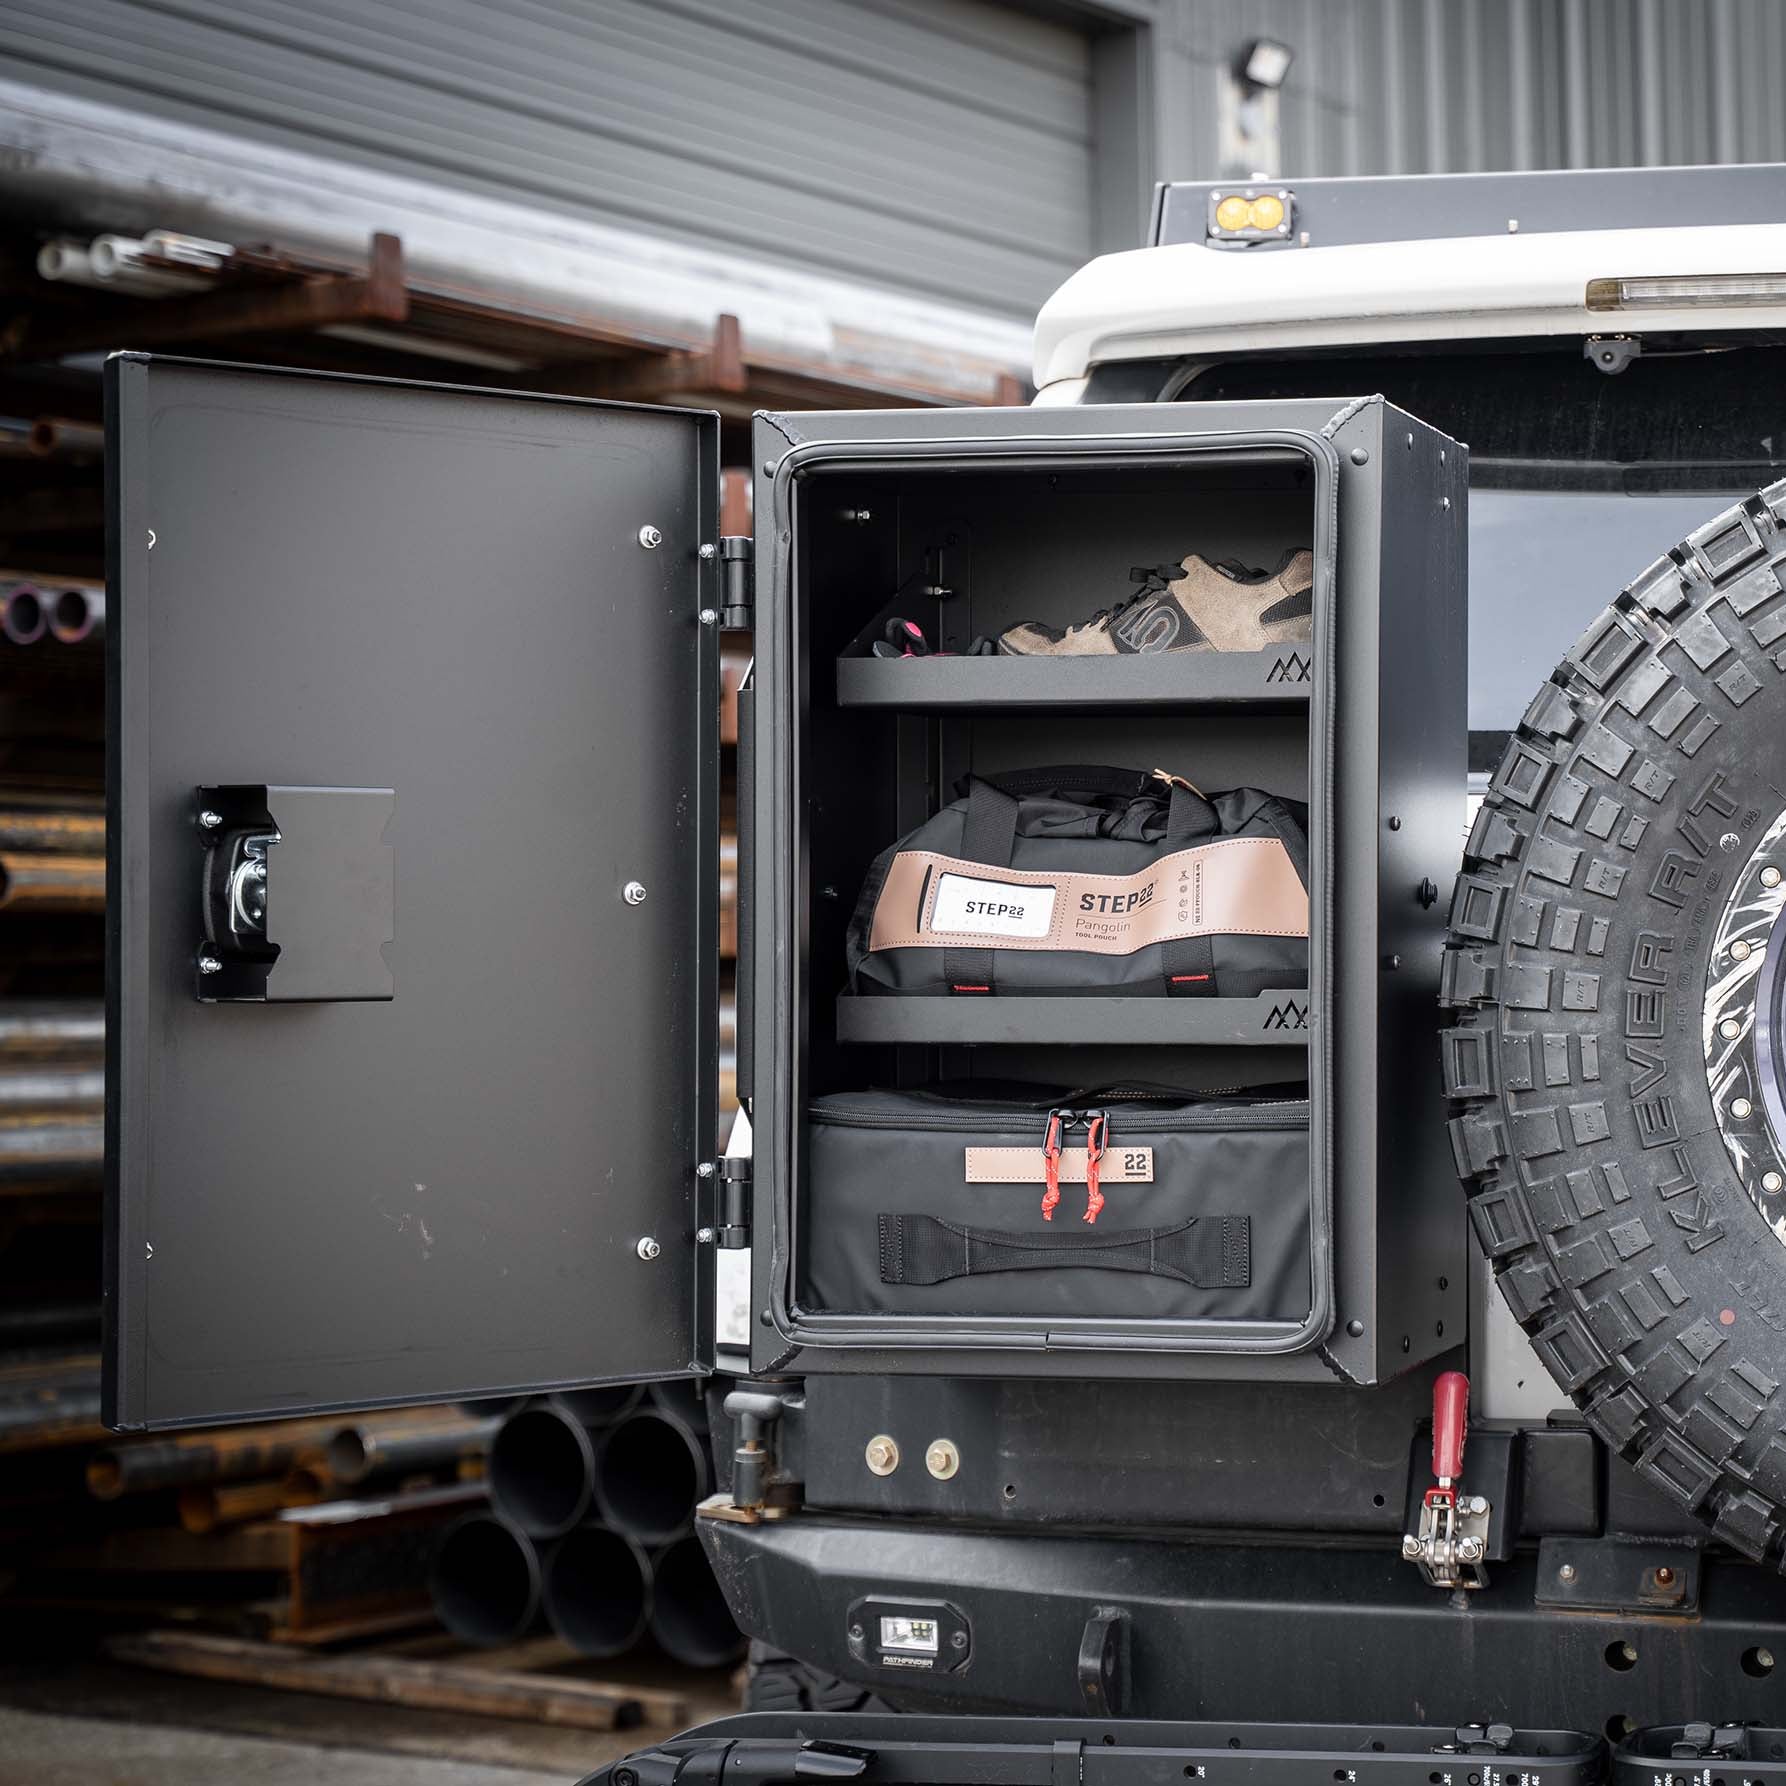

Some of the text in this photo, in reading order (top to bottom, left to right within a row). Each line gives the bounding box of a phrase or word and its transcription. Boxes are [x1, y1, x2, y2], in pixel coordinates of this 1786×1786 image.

[966, 901, 1025, 918] STEP22
[1080, 882, 1154, 914] STEP22
[1075, 918, 1131, 934] Pangolin
[1625, 769, 1738, 1255] KLEVER R/T
[1124, 1153, 1147, 1176] 22
